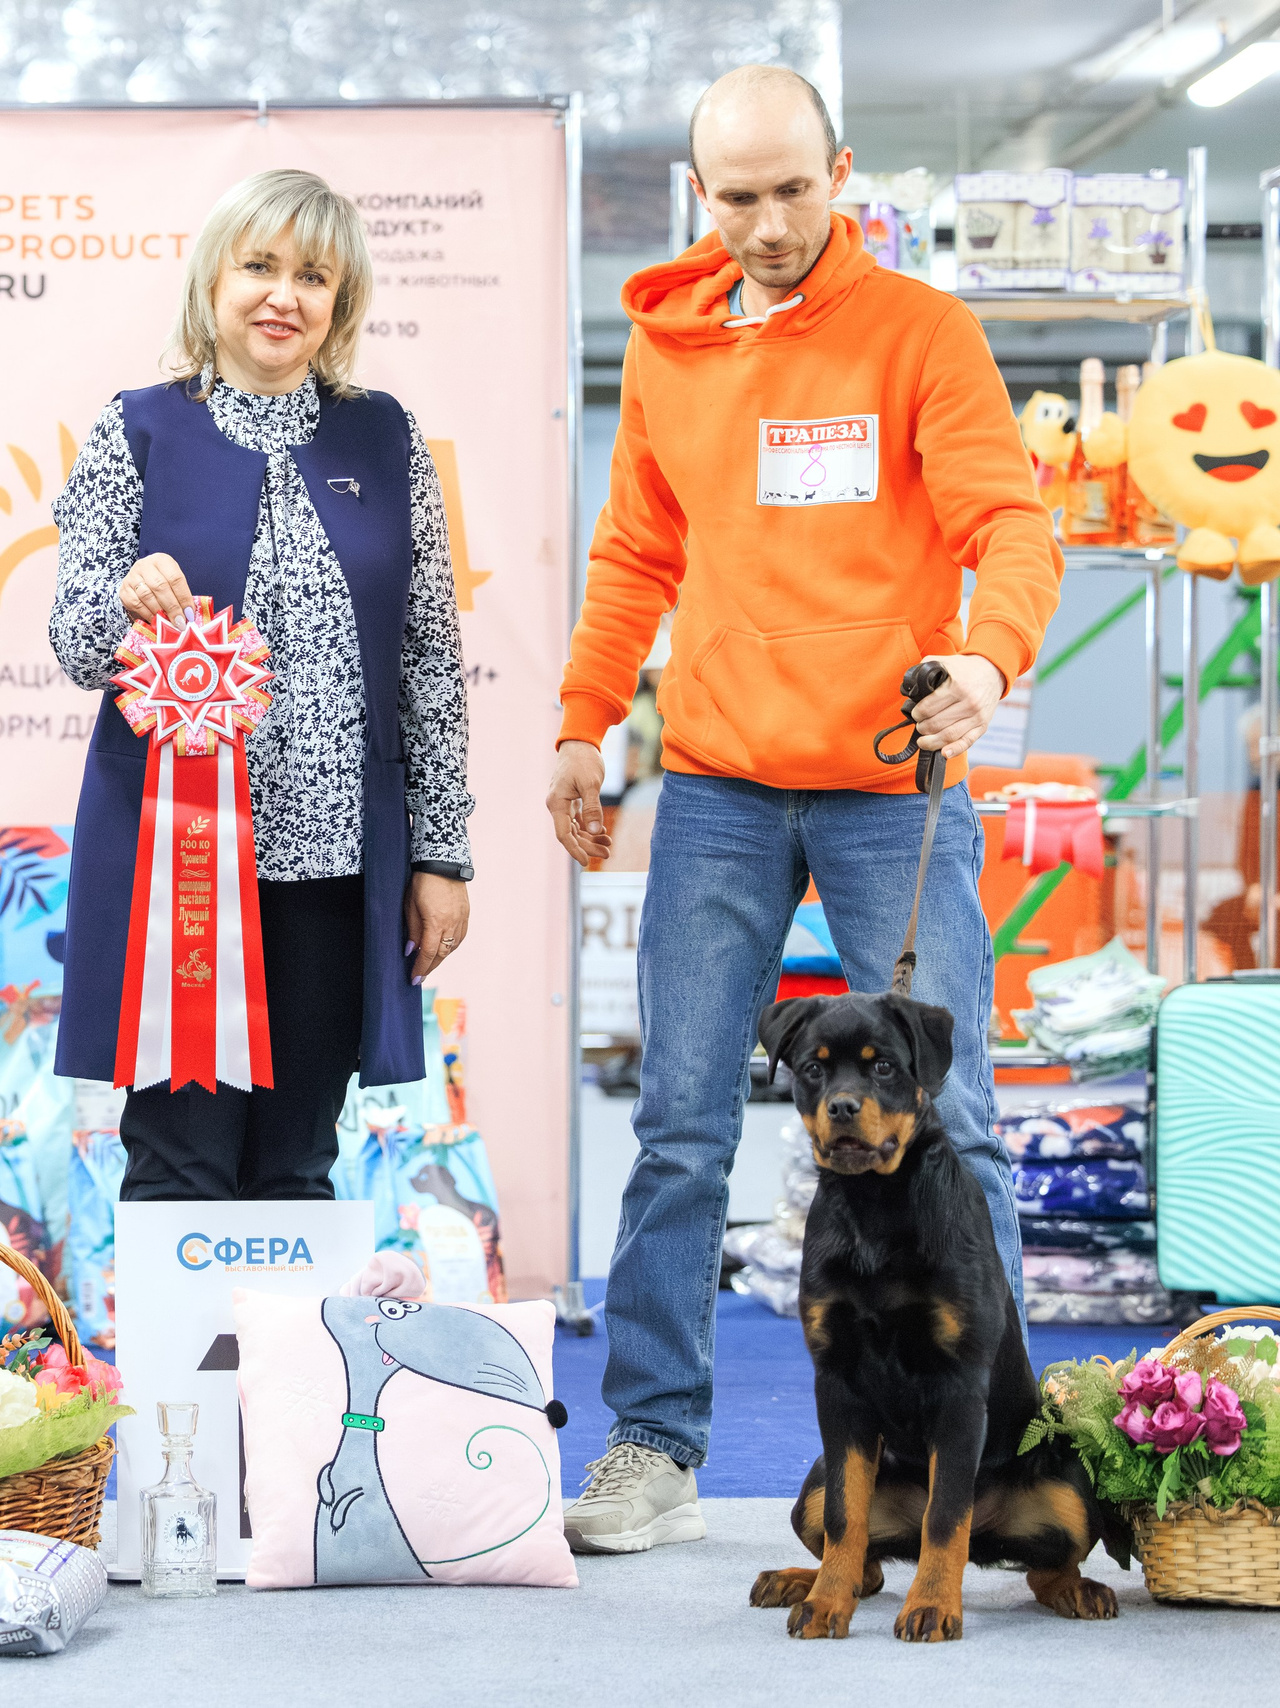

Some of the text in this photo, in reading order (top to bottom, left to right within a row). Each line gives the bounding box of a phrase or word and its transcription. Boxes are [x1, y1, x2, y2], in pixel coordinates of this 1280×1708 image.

[356, 189, 484, 210] КОМПАНИЙ
[769, 422, 865, 444] ТРАПЕЗА
[800, 444, 827, 487] 8
[179, 907, 210, 923] Лучший
[184, 922, 205, 936] Беби
[177, 1232, 313, 1271] СФЕРА
[224, 1264, 315, 1273] ВЫСТАВОЧНЫЙ ЦЕНТР
